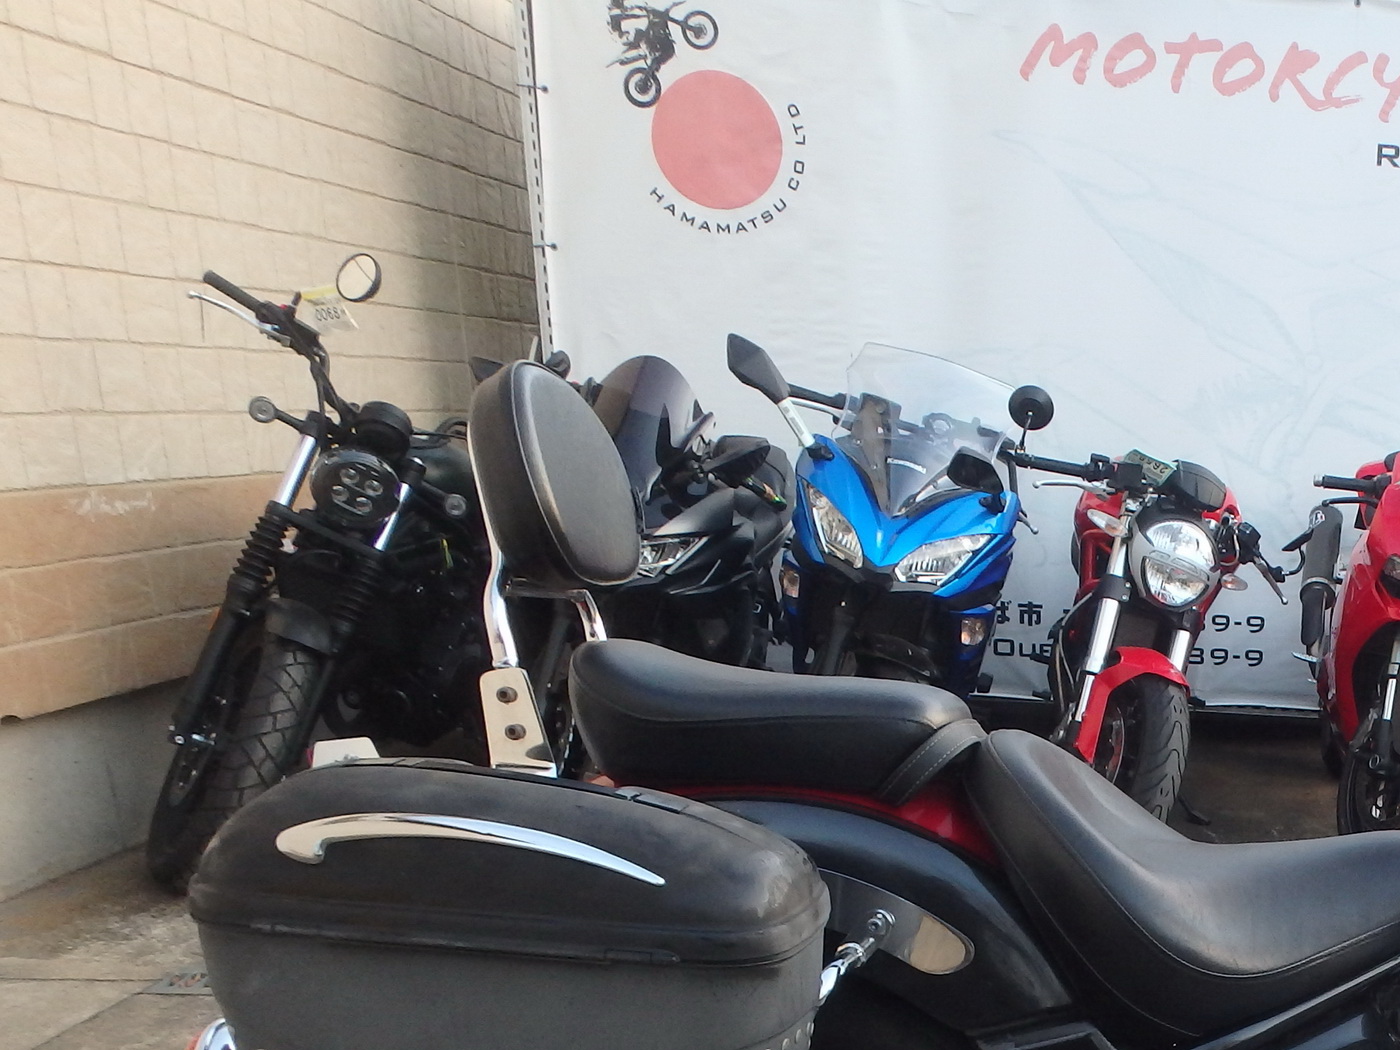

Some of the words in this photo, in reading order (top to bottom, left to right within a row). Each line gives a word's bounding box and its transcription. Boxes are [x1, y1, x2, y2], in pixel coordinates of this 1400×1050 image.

[787, 103, 806, 145] LTD
[787, 160, 805, 191] CO
[650, 187, 787, 234] HAMAMATSU
[1203, 614, 1265, 633] 9-9
